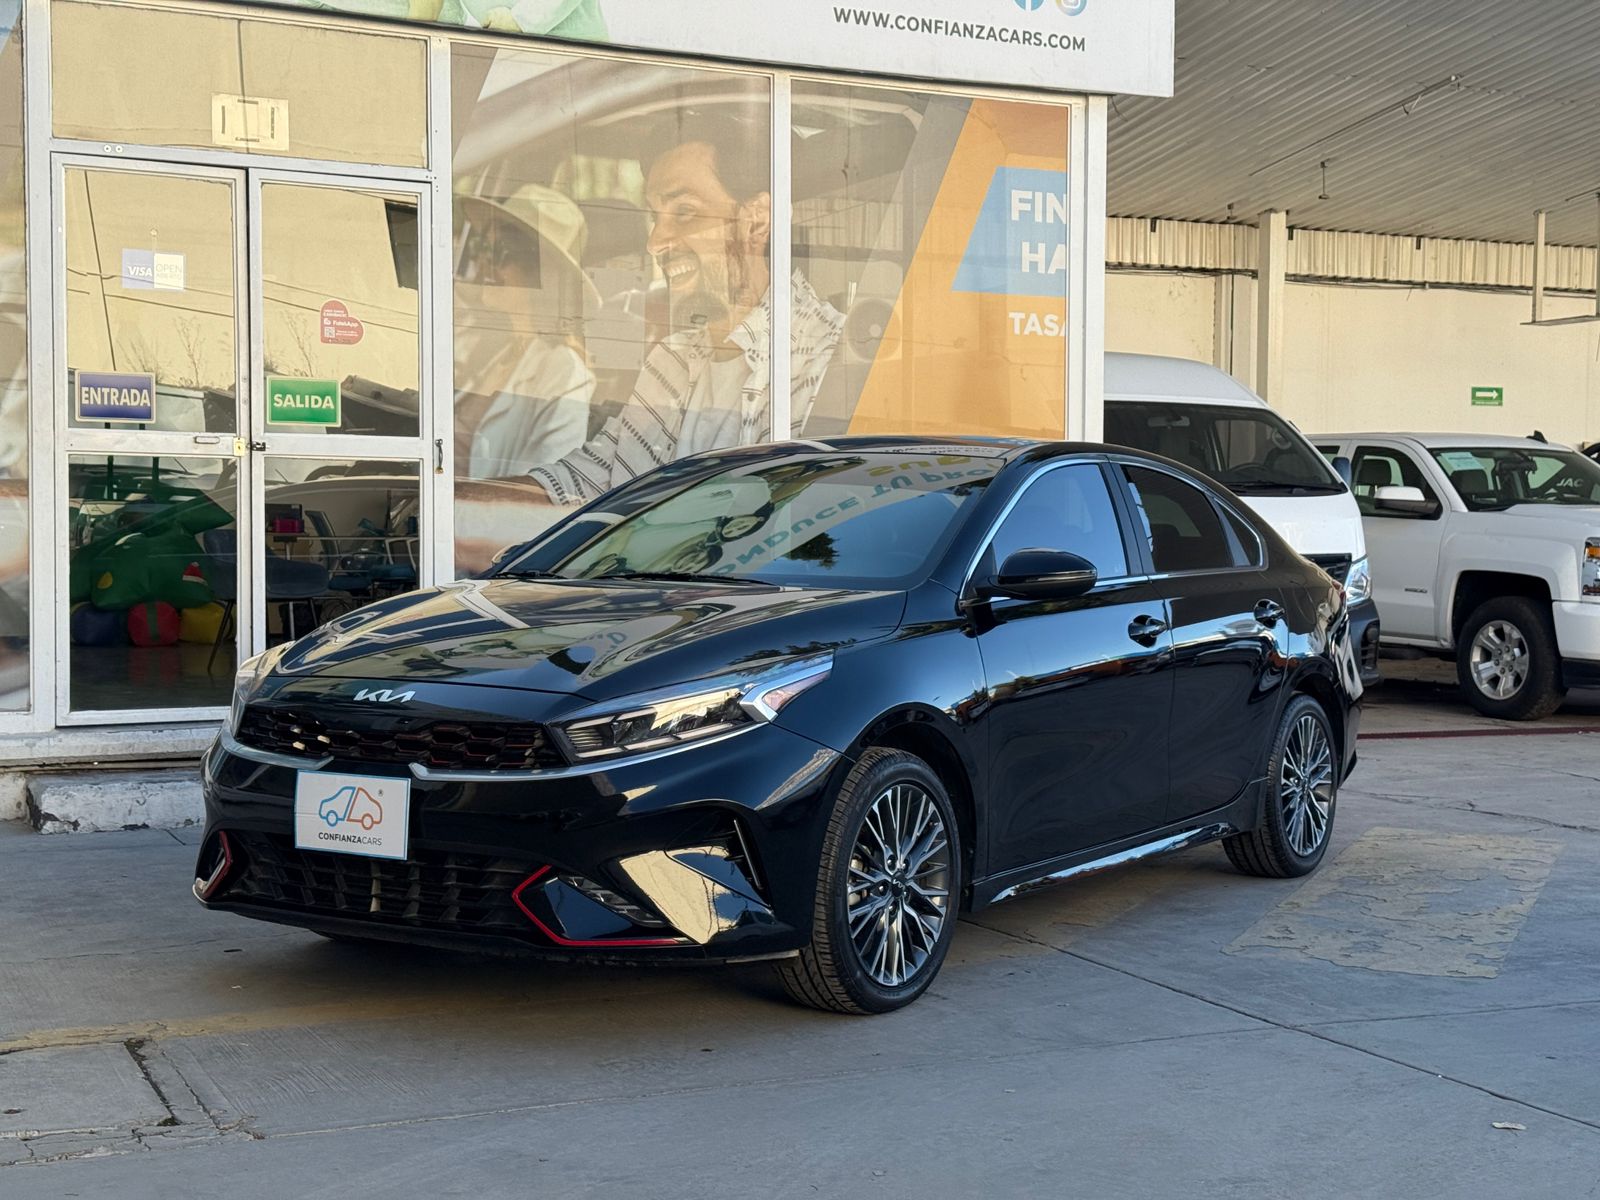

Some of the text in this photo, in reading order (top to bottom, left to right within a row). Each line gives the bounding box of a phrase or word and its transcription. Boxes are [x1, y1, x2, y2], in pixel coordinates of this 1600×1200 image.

[833, 6, 1086, 52] WWW.CONFIANZACARS.COM
[1011, 189, 1067, 224] FIN
[127, 266, 153, 277] VISA
[156, 263, 182, 273] OPEN
[80, 386, 152, 407] ENTRADA
[273, 392, 335, 411] SALIDA
[353, 688, 416, 703] KIA
[318, 832, 382, 846] CONFIANZACARS
